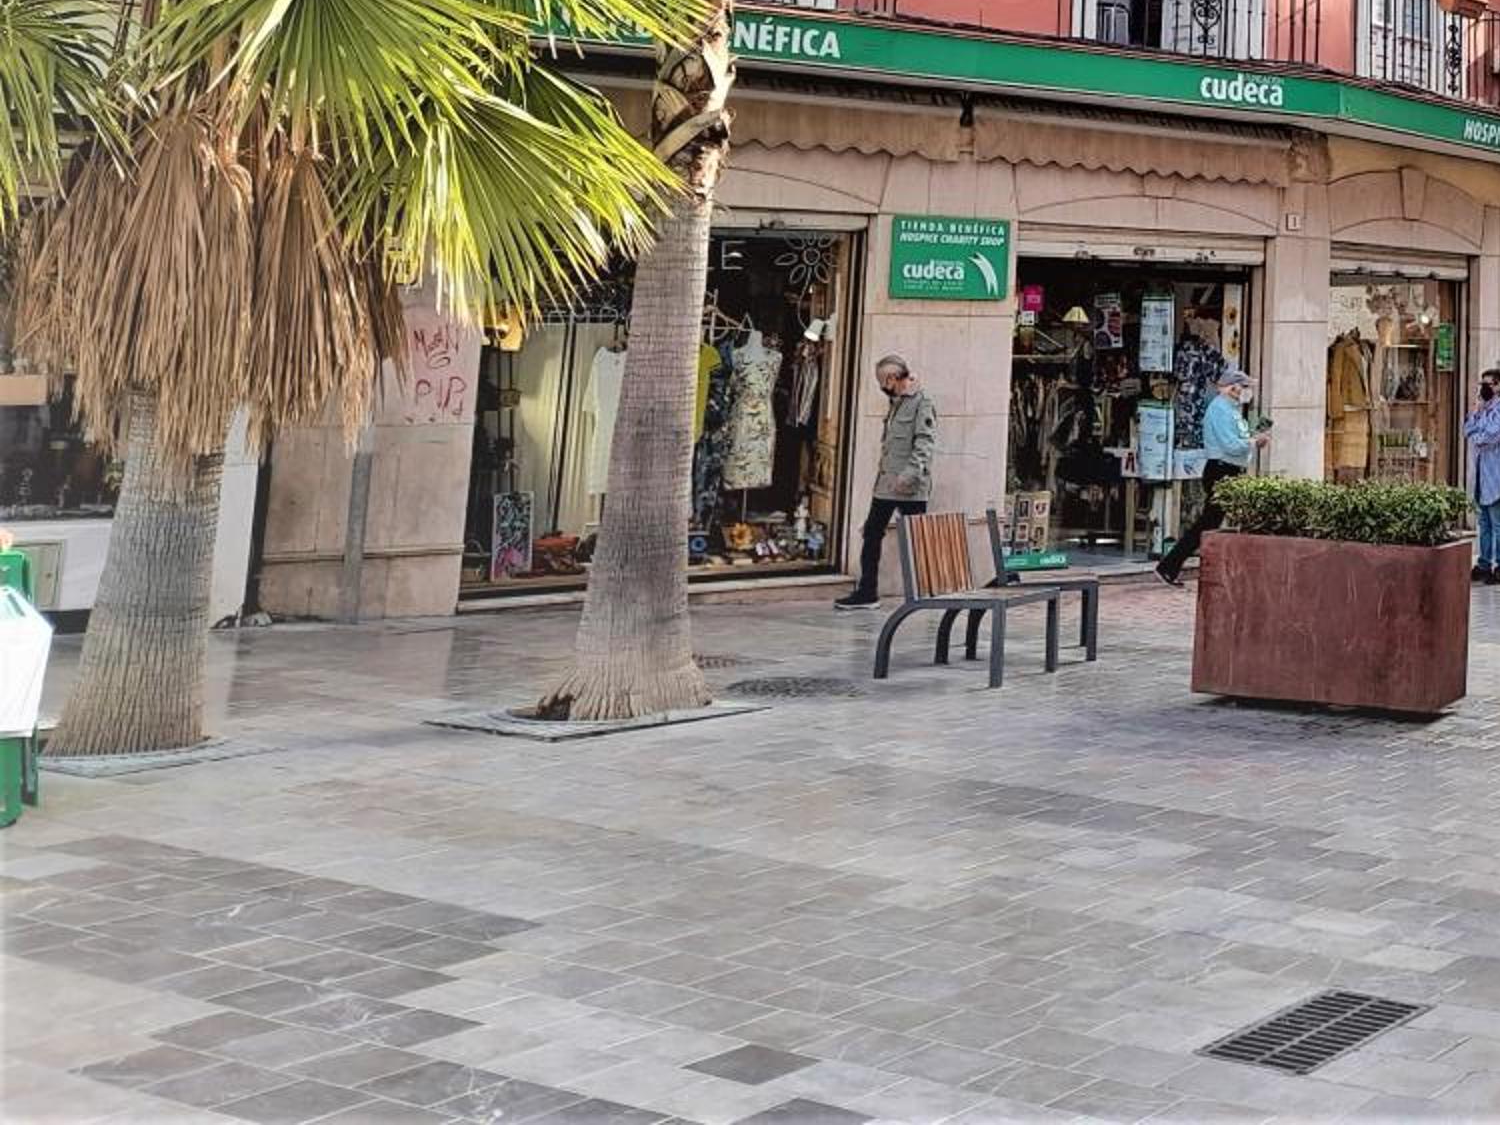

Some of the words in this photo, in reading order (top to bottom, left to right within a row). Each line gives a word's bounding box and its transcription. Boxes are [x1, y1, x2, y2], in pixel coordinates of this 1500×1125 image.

[732, 16, 840, 58] NÉFICA
[1200, 73, 1283, 106] cudeca
[901, 220, 944, 233] TIENDA
[949, 223, 1005, 236] BENÉFICA
[903, 259, 965, 280] cudeca
